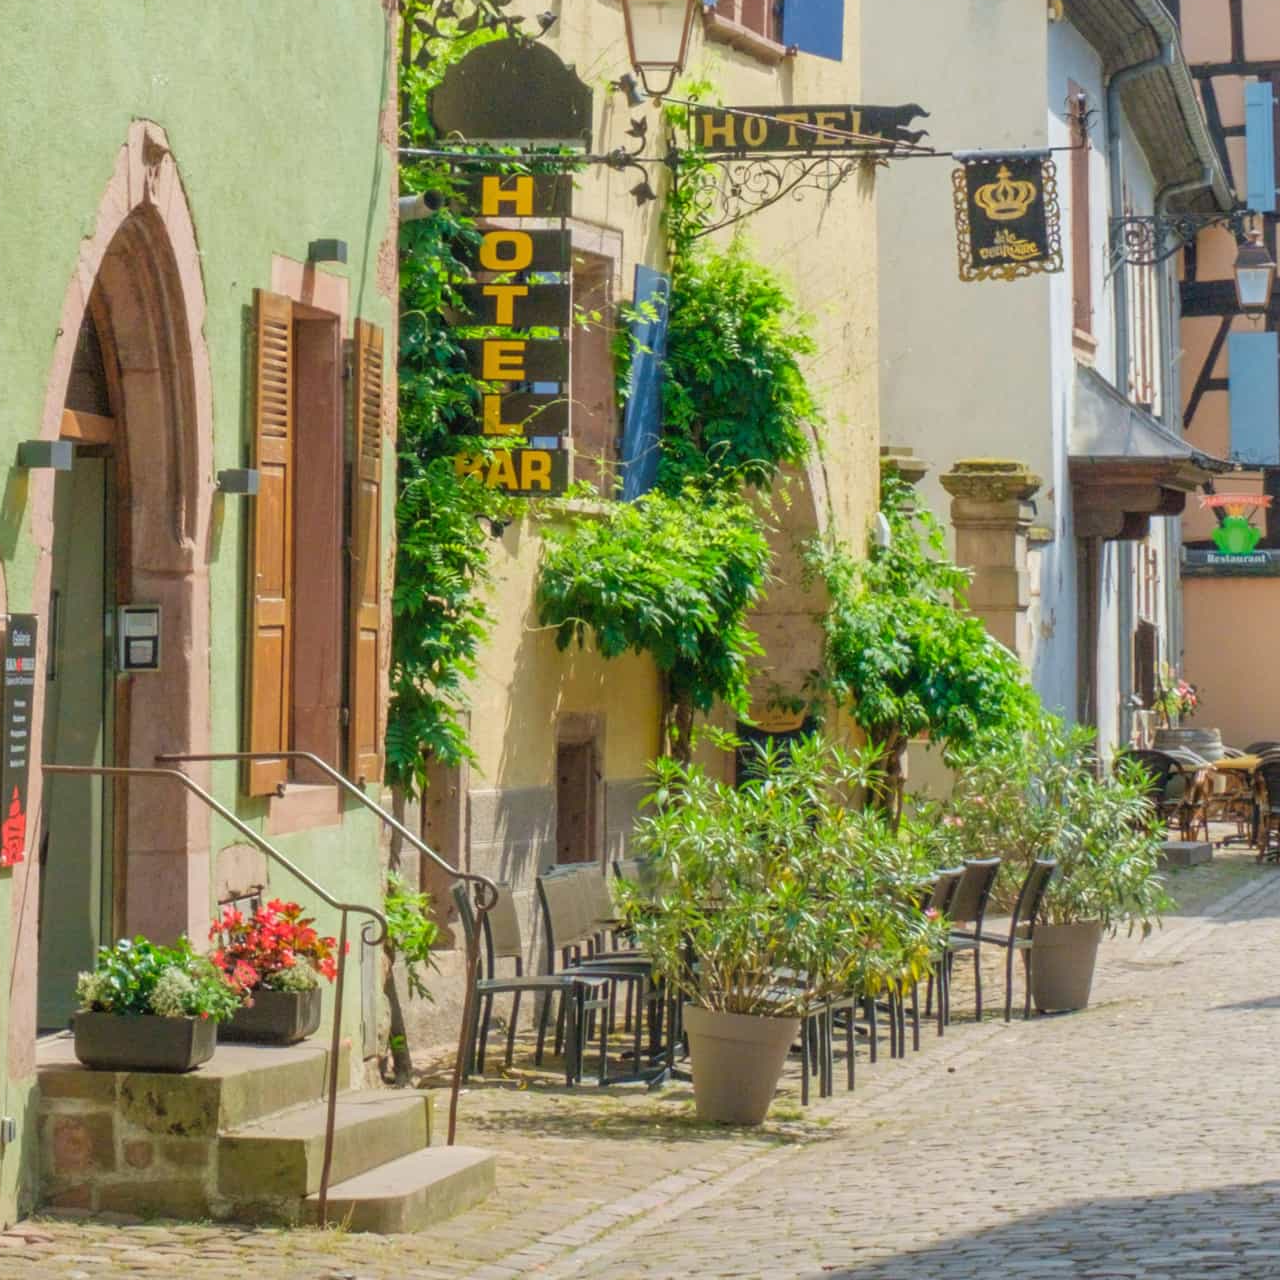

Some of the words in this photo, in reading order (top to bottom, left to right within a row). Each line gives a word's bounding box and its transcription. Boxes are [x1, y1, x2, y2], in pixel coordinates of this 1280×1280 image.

[702, 111, 883, 147] HOTEL
[479, 176, 534, 435] HOTEL
[1207, 552, 1266, 564] Restaurant
